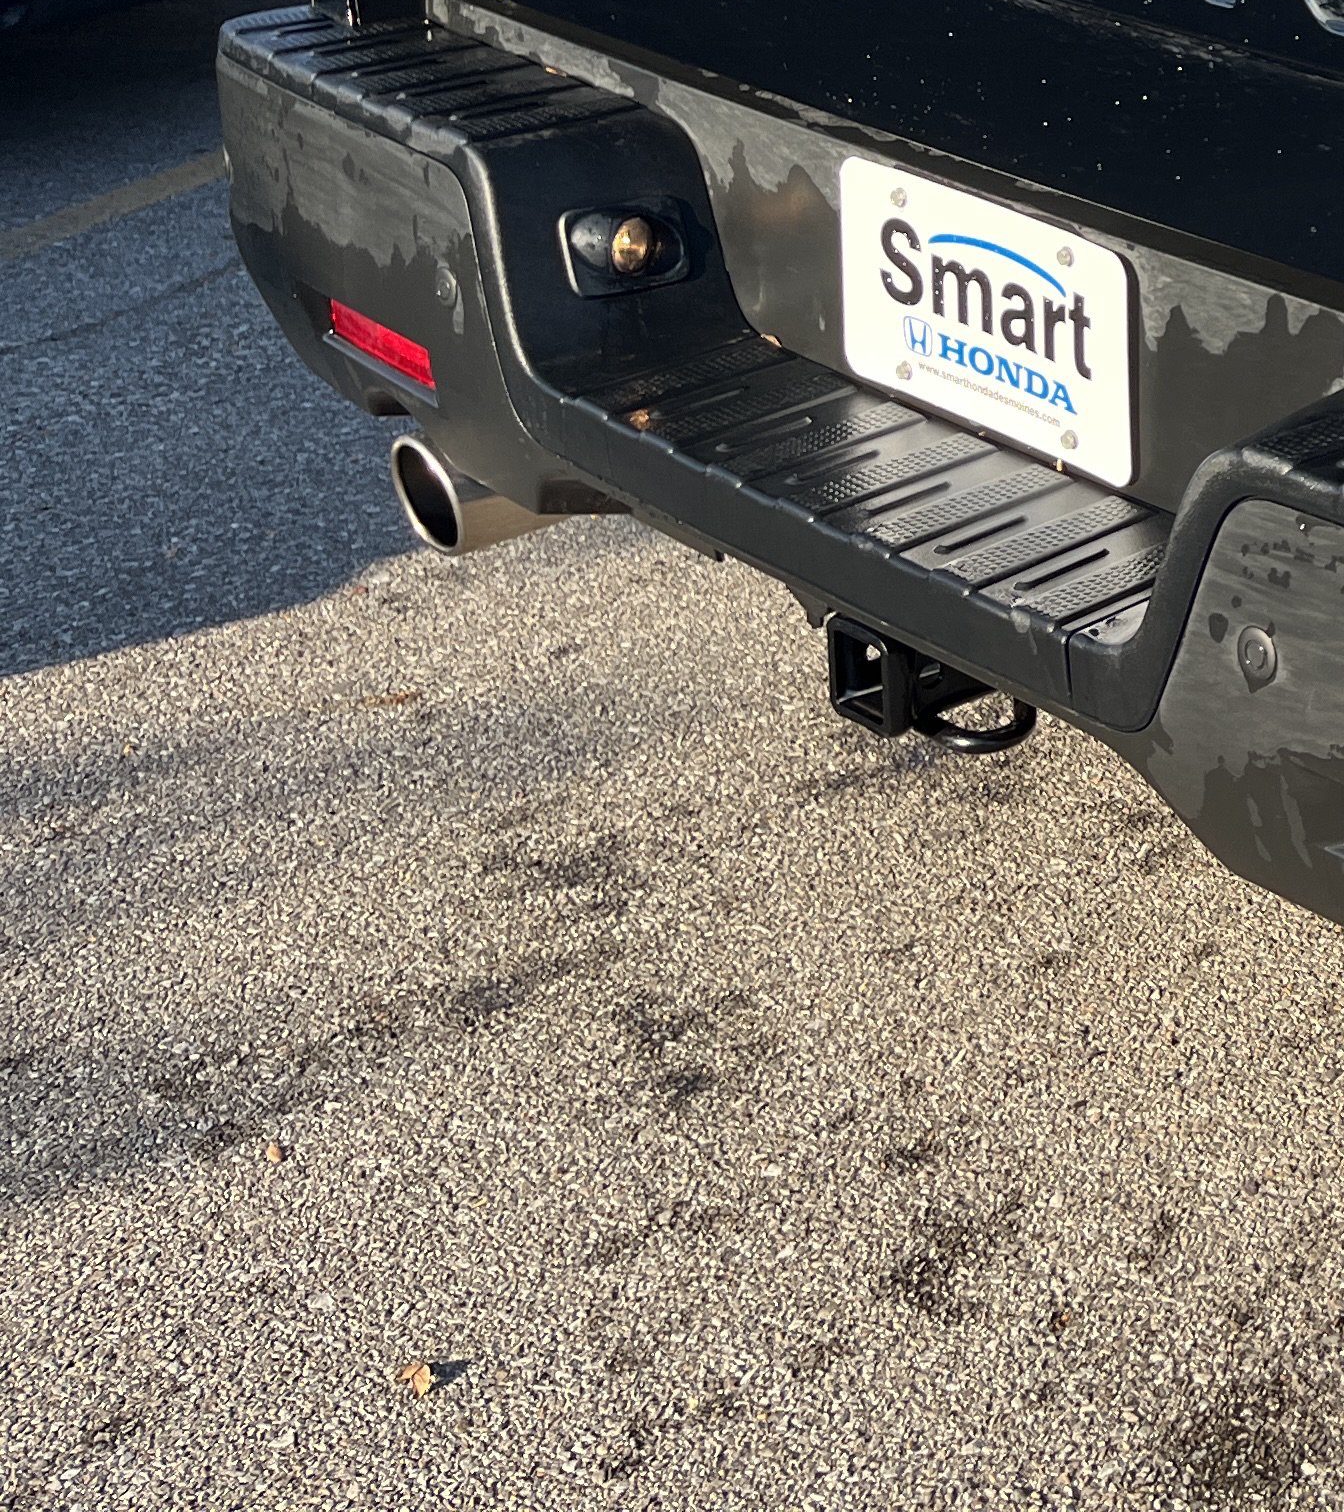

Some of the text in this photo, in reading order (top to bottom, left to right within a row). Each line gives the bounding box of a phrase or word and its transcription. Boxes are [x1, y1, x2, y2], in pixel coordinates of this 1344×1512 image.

[879, 217, 1093, 382] Smart
[918, 360, 1062, 428] www.smarthondadesmoines.com
[937, 332, 1078, 416] HONDA
